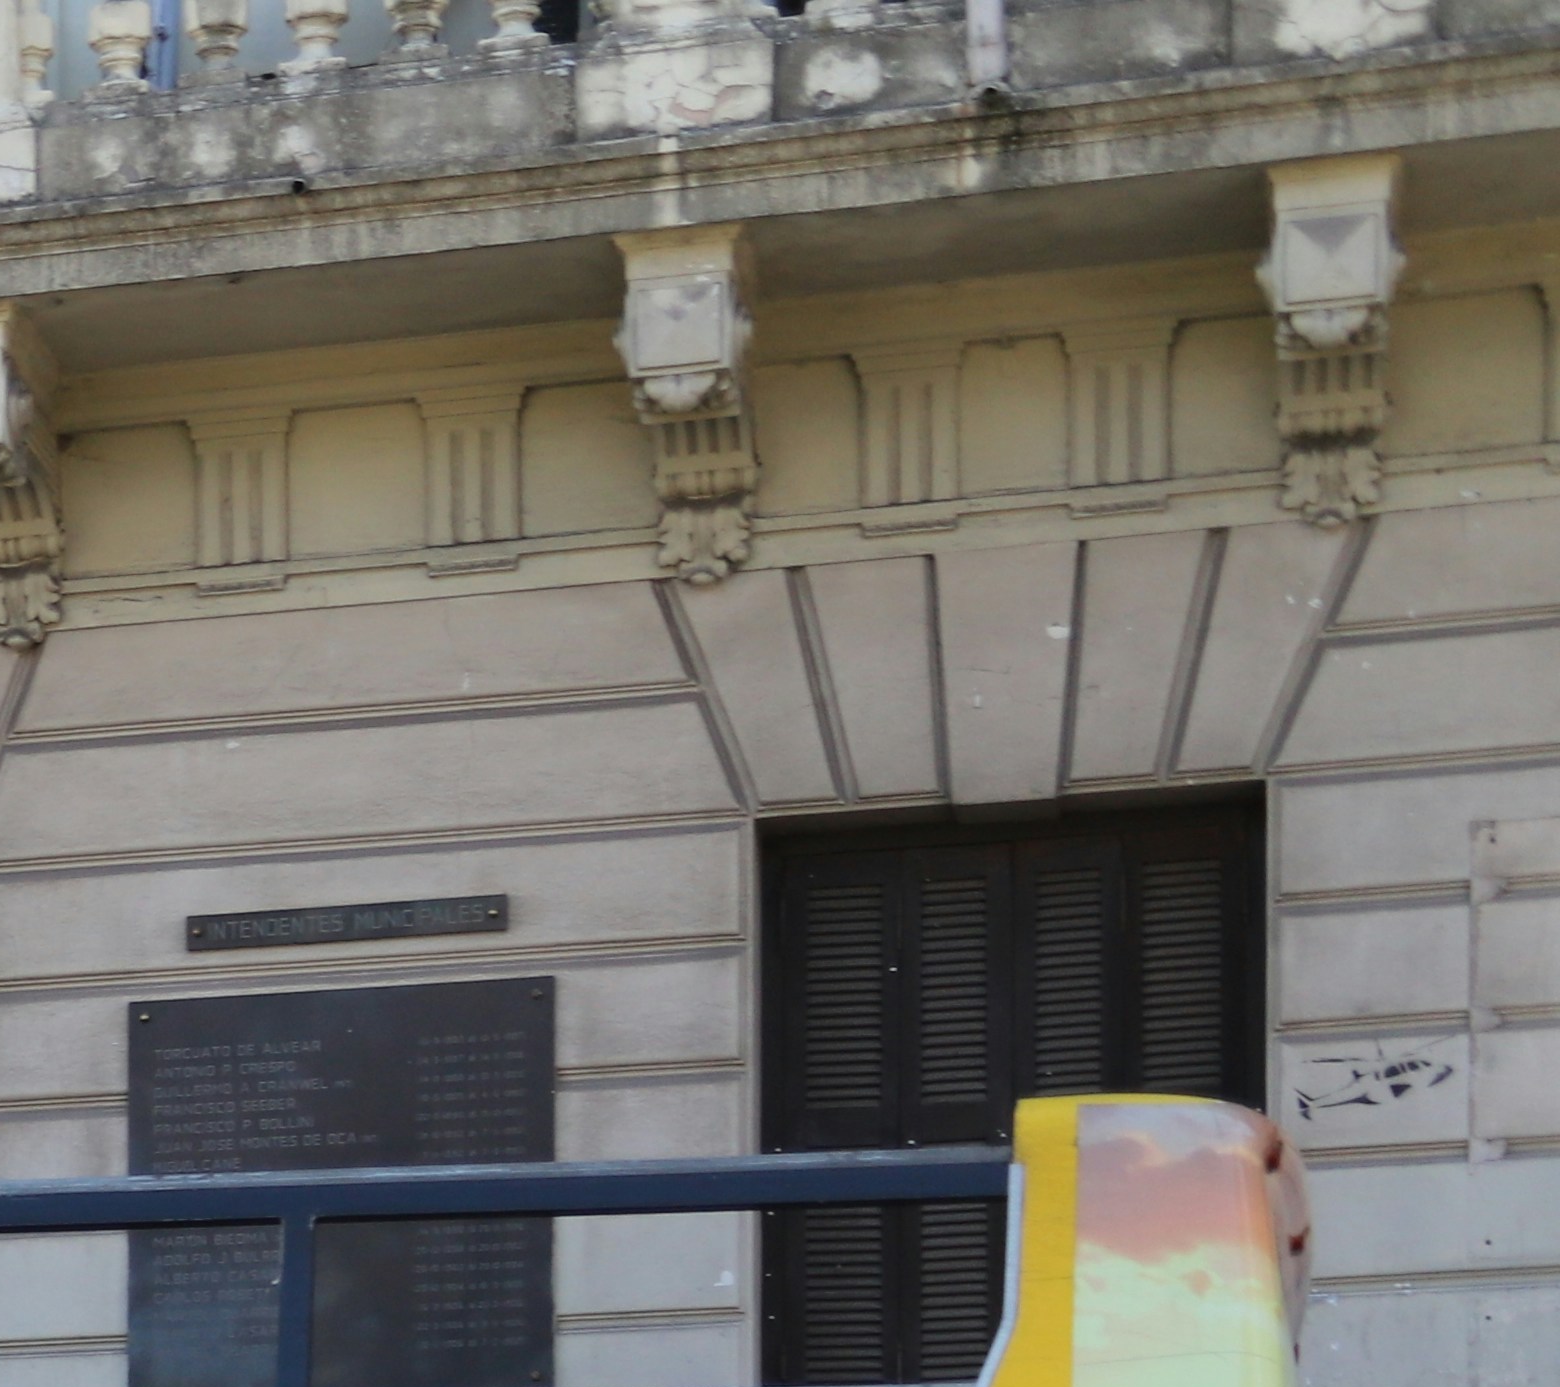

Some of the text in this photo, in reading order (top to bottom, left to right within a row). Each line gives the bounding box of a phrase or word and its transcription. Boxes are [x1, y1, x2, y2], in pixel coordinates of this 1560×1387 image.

[208, 904, 484, 940] INTENDENTES MUNICIPALES
[237, 1044, 255, 1056] DE
[154, 1101, 236, 1117] FRANCISCO
[154, 1119, 236, 1135] FRANCISCO
[303, 1133, 321, 1146] DE
